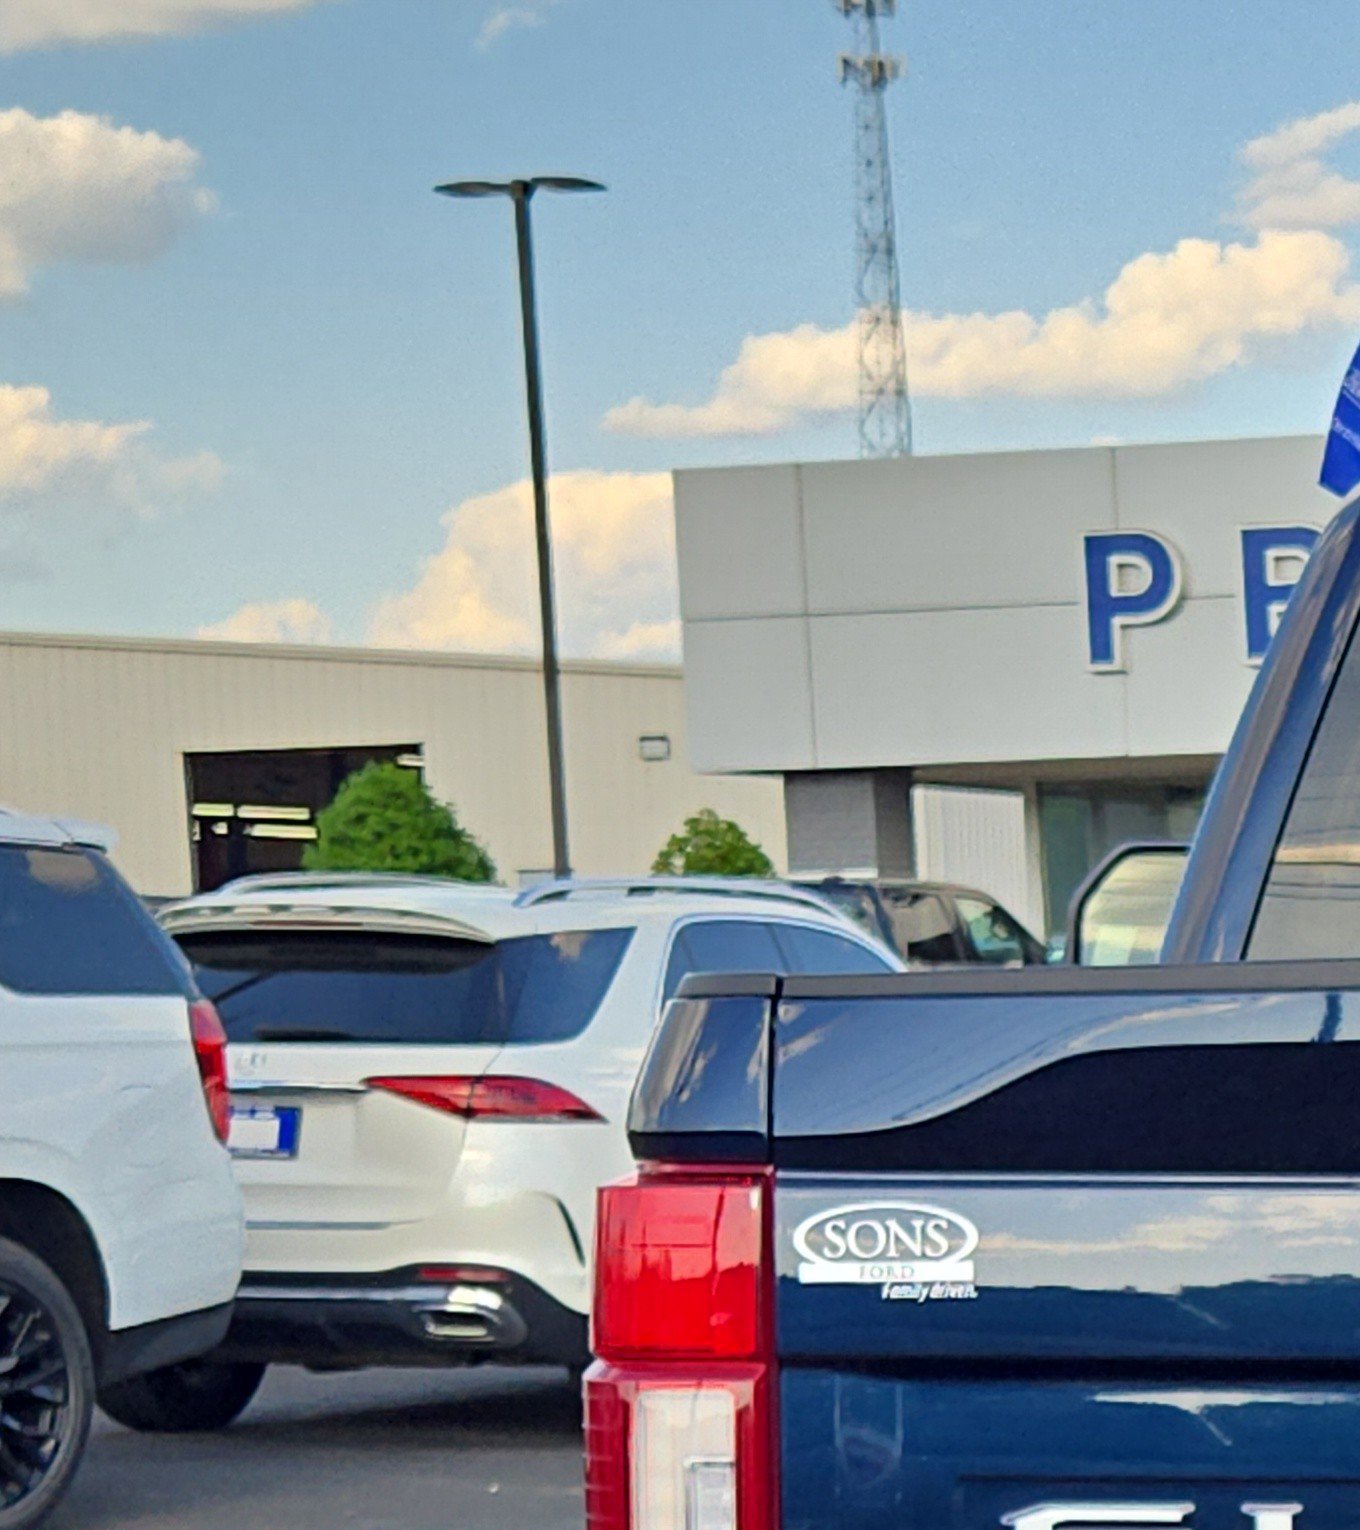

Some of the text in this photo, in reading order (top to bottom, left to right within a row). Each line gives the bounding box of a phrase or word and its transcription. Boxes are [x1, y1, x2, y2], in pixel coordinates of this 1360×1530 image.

[822, 1218, 949, 1259] SONS
[859, 1265, 915, 1280] FORD
[881, 1283, 929, 1303] Family
